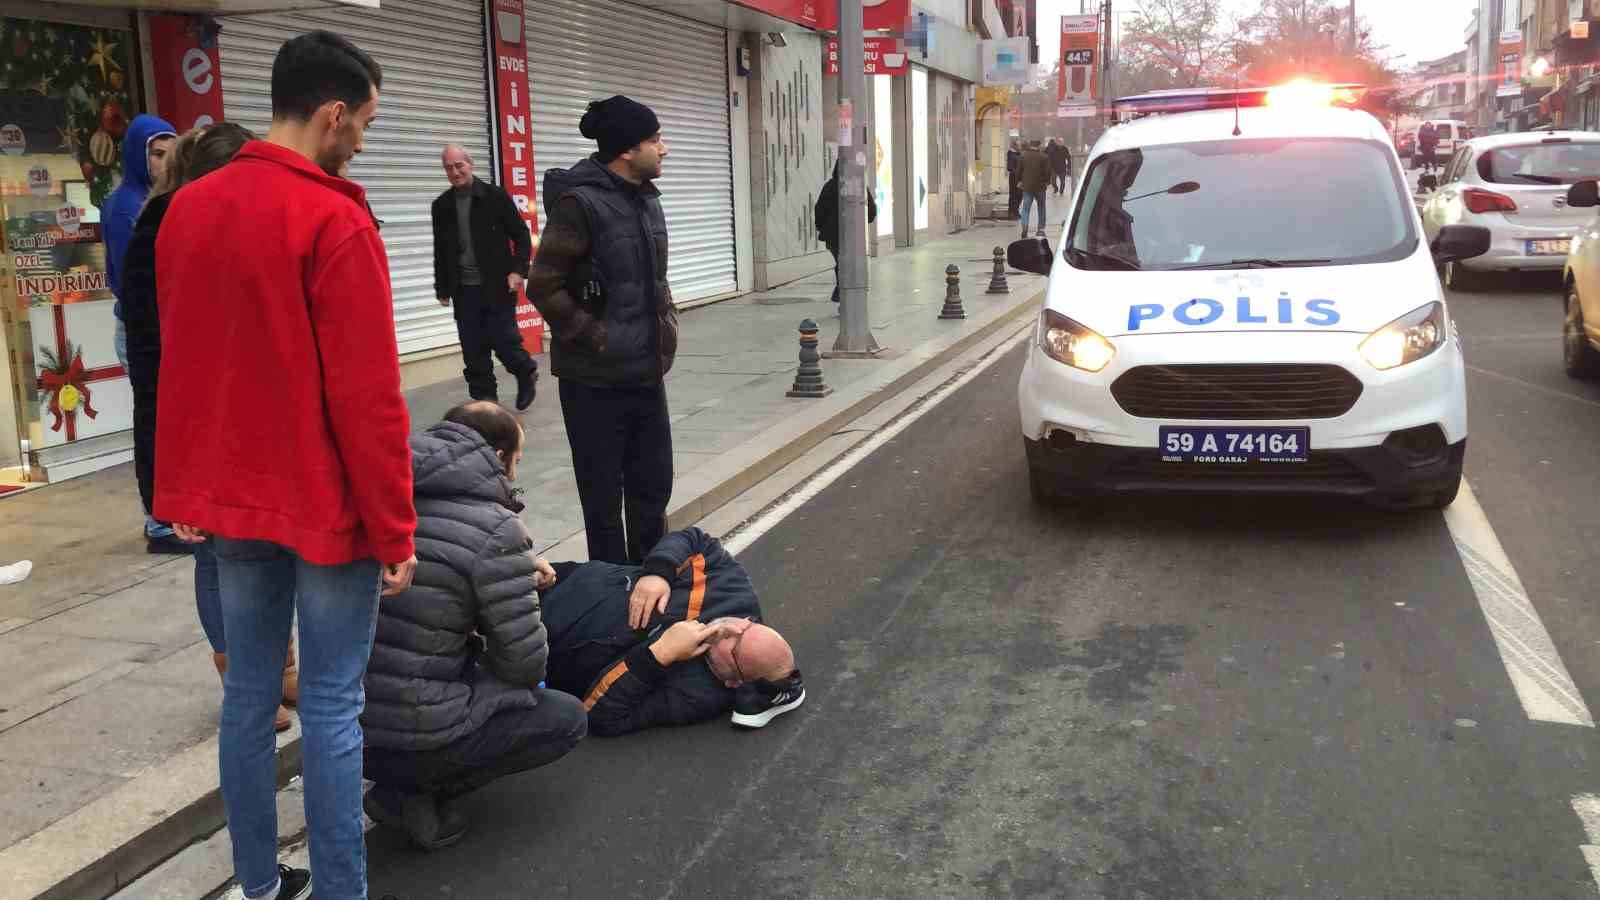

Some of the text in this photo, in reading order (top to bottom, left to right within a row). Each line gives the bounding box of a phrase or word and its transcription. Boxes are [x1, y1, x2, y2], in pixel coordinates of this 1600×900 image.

[499, 55, 526, 73] EVDE
[1127, 291, 1341, 331] POLİS
[1166, 433, 1298, 453] 59 A 74164
